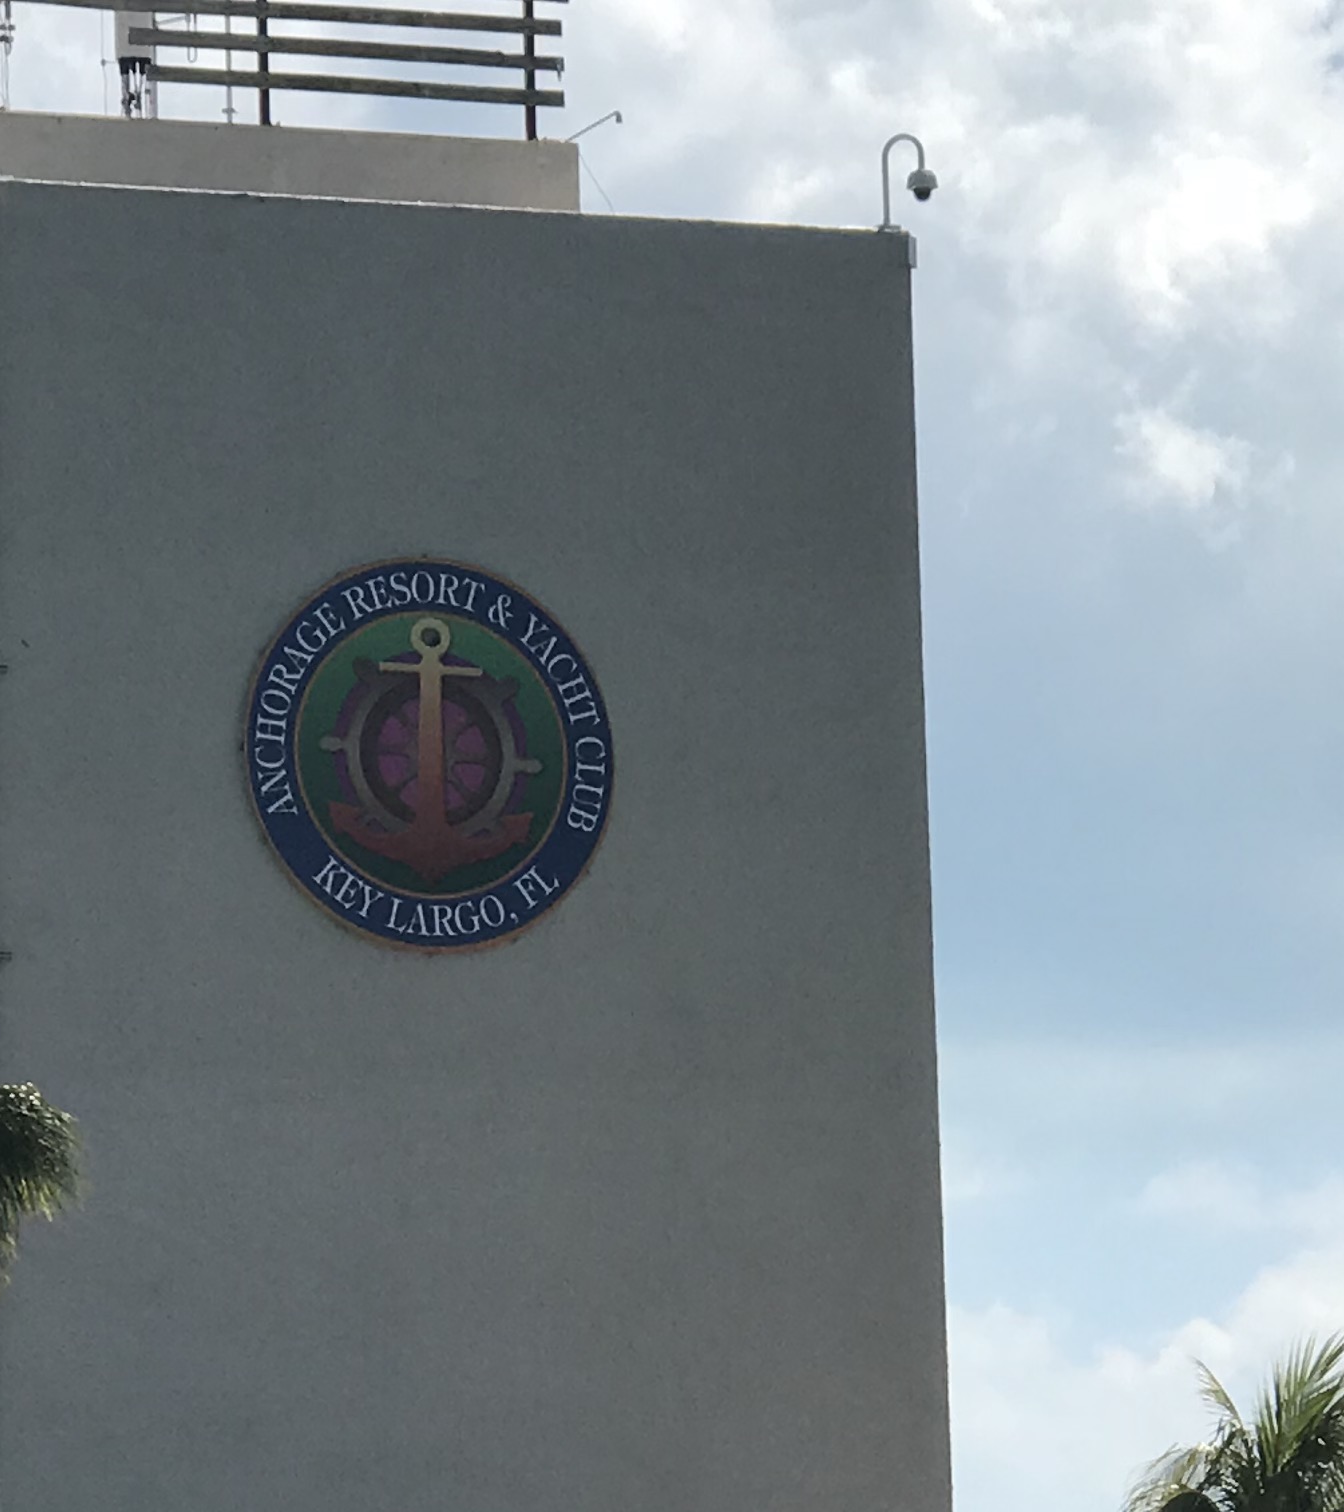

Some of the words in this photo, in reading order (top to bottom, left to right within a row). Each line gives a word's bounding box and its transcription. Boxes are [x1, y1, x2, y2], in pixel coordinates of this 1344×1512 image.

[255, 602, 346, 816] ANCHORAGE
[340, 571, 486, 621] RESORT
[488, 593, 515, 629] &
[519, 612, 601, 726] YACHT
[567, 736, 606, 833] CLUB
[312, 855, 384, 919] KEY
[387, 894, 520, 937] LARGO,
[513, 864, 561, 910] FL
